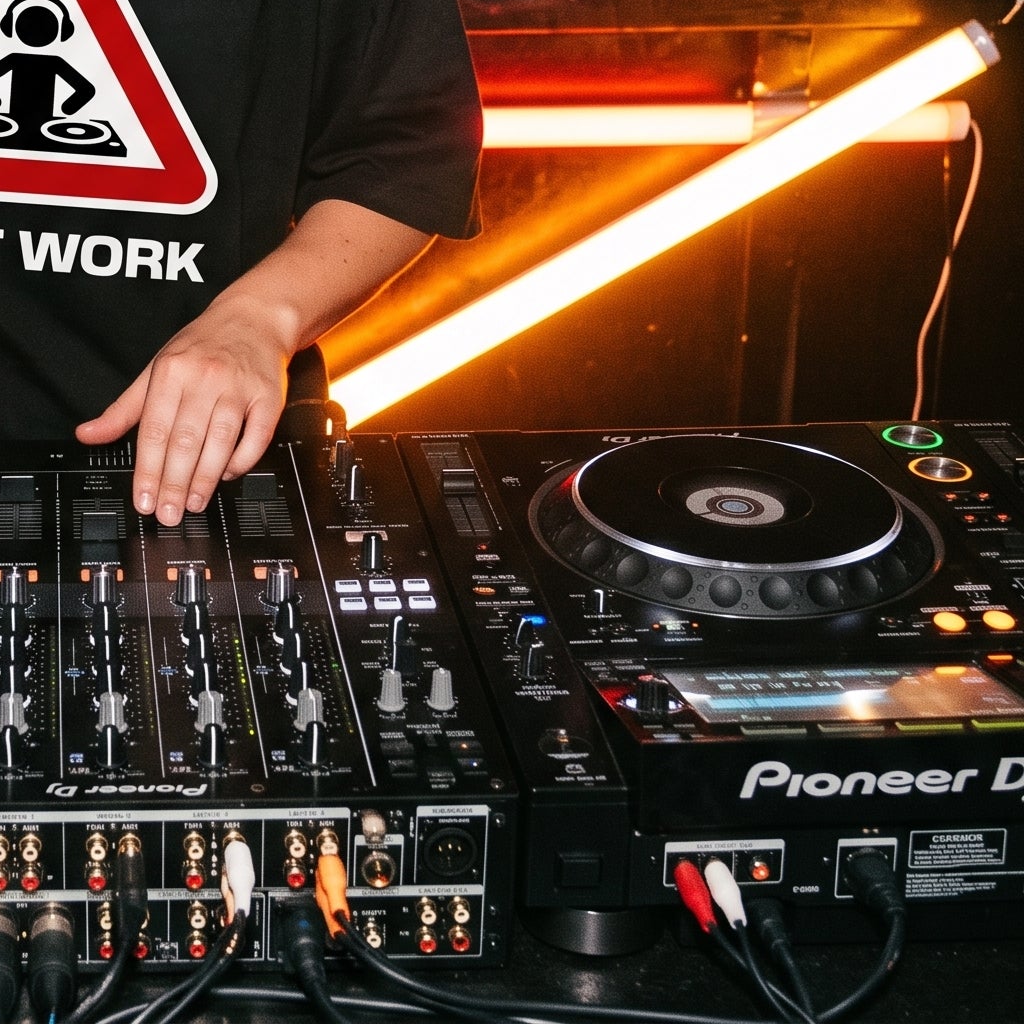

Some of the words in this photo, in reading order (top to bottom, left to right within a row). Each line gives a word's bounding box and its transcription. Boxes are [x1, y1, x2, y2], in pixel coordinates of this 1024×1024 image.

[18, 230, 205, 283] WORK
[84, 783, 208, 797] Pioneer
[739, 760, 979, 799] Pioneer
[990, 756, 1024, 802] D
